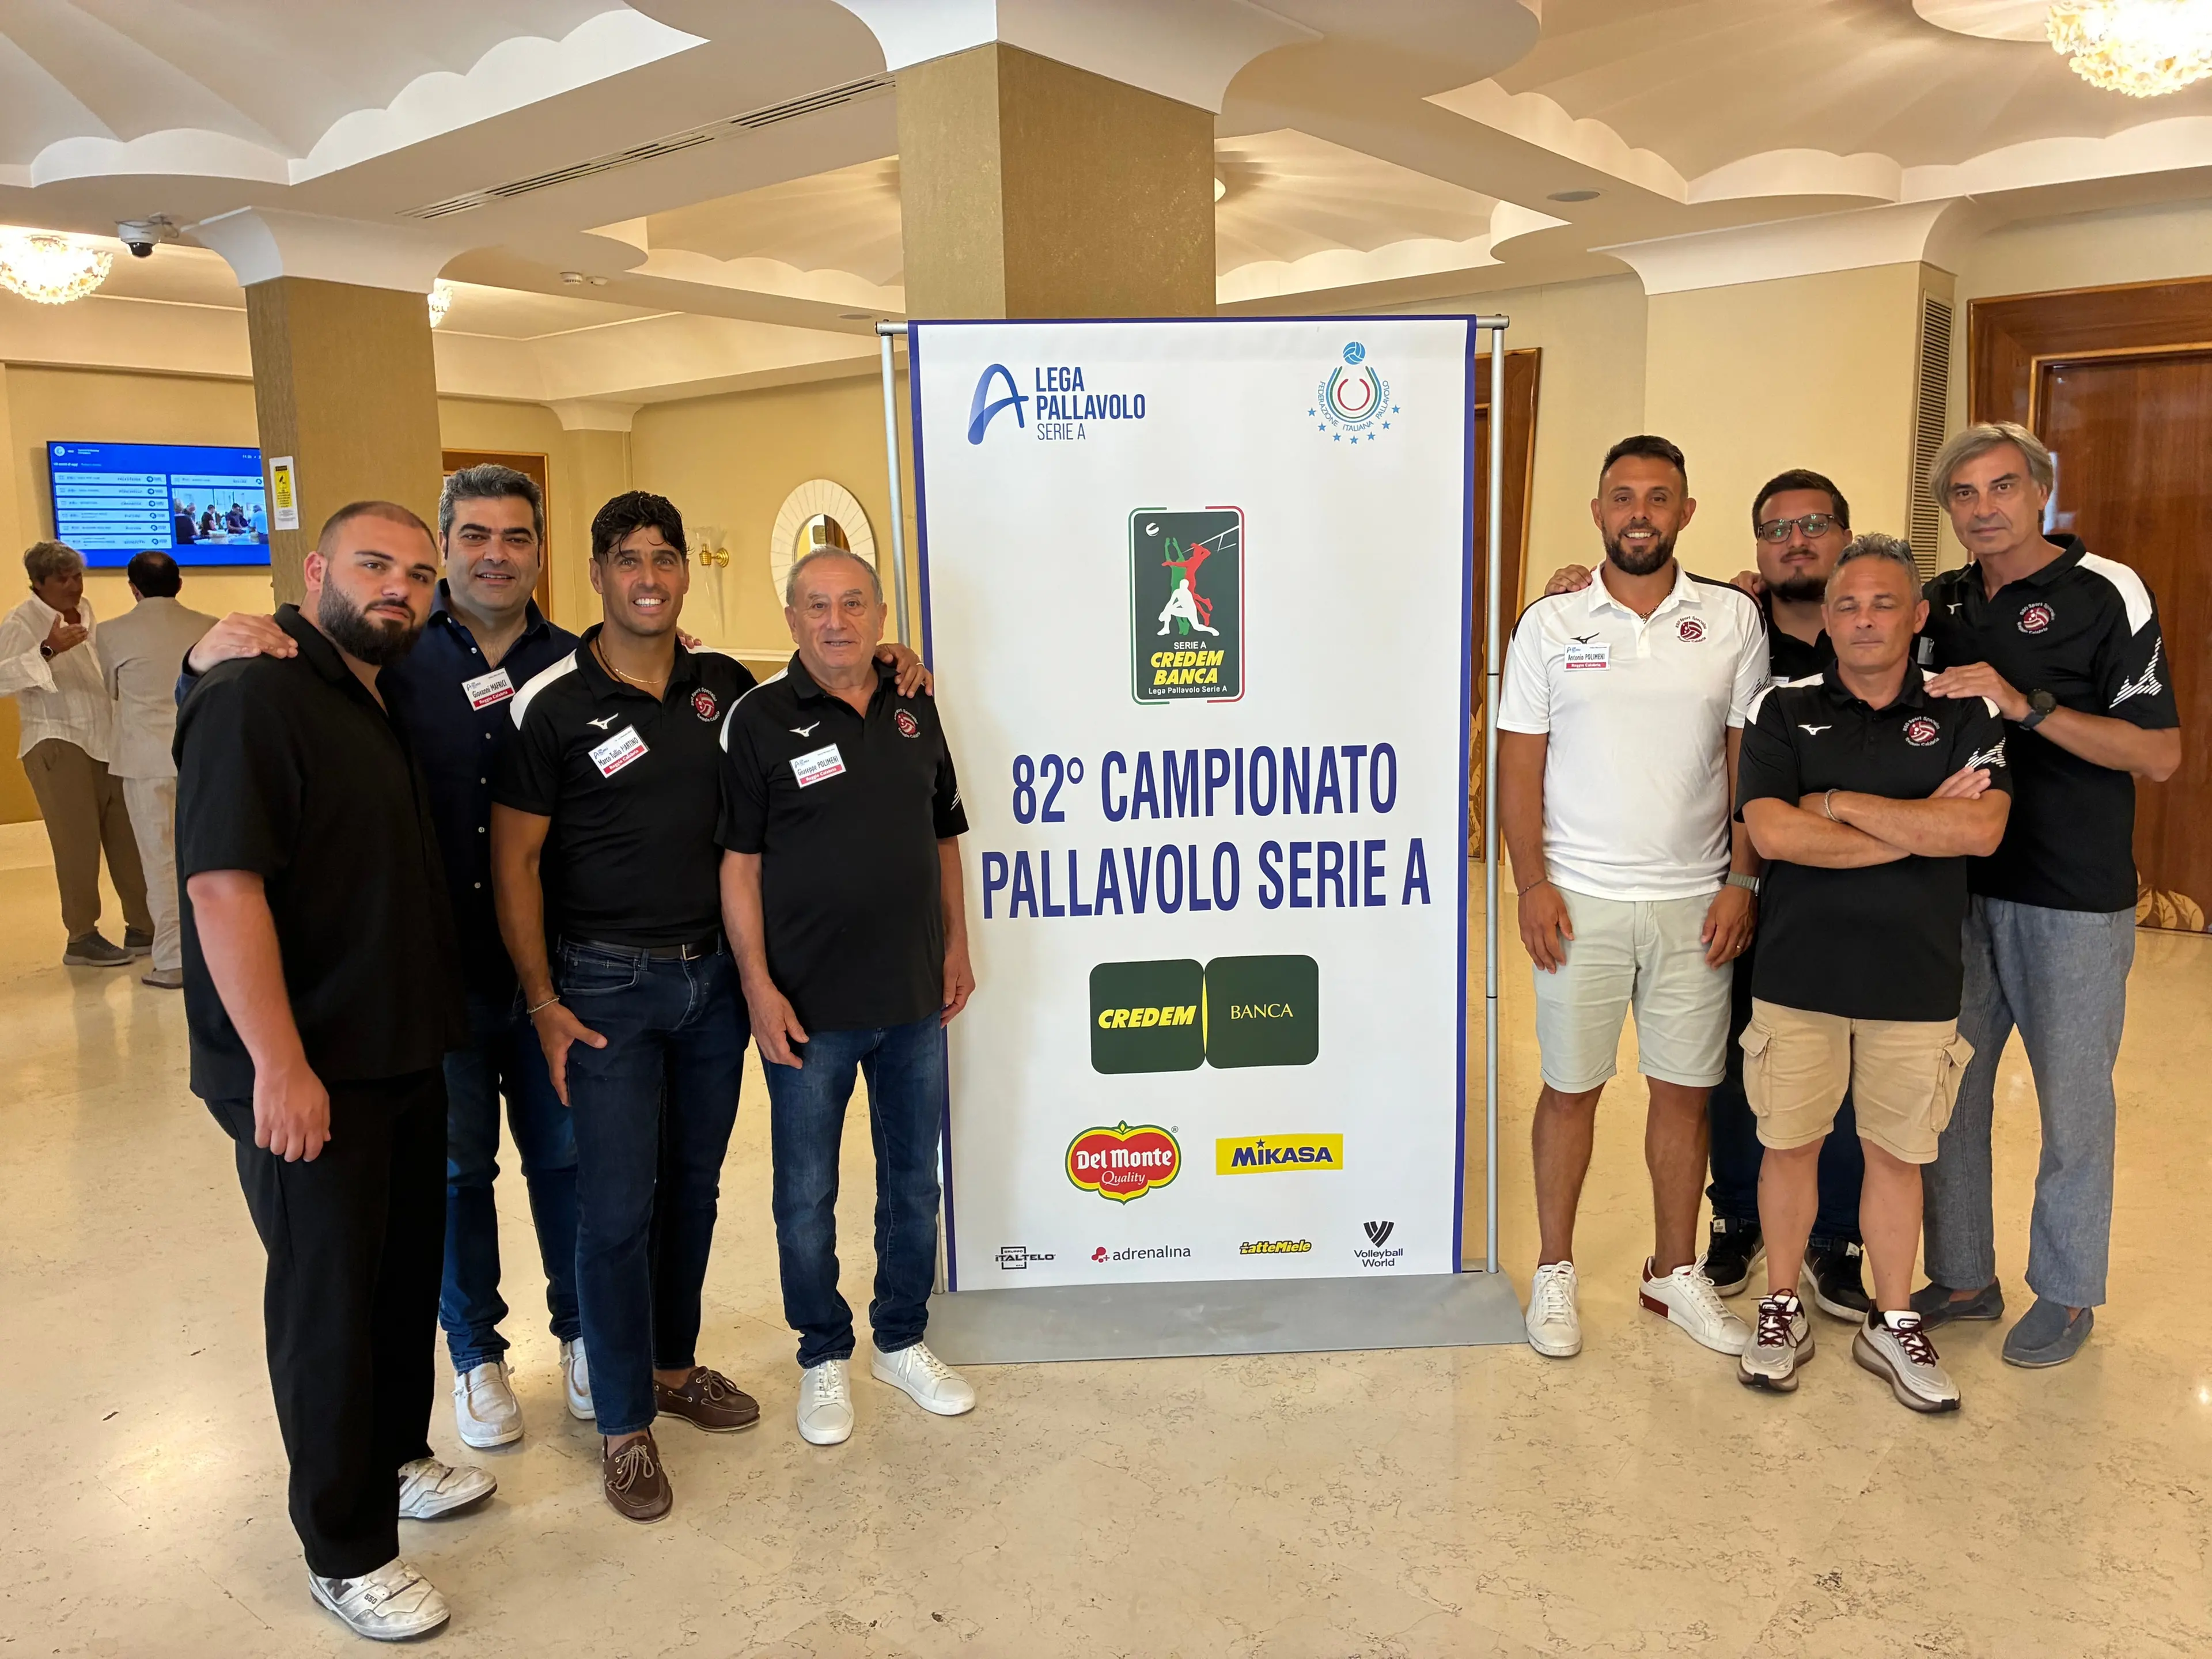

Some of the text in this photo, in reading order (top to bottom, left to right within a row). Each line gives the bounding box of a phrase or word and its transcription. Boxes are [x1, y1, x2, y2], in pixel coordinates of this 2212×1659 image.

[1036, 367, 1085, 392] LEGA
[1036, 394, 1145, 420] PALLAVOLO
[1318, 380, 1390, 431] FEDERAZIONE ITALIANA PALLAVOLO
[1037, 423, 1086, 440] SERIE A
[1173, 641, 1198, 650] SERIE
[1150, 650, 1224, 668] CREDEM
[1153, 668, 1218, 685] BANCA
[472, 685, 491, 698] Giovanni
[493, 691, 508, 699] Calabria
[1168, 686, 1200, 694] Pallavolo
[598, 756, 611, 766] Marco
[609, 749, 622, 759] Tullio
[797, 764, 817, 777] Giuseppe
[817, 755, 839, 769] POLIMENI
[1101, 742, 1397, 823] CAMPIONATO
[982, 838, 1431, 919] PALLAVOLO SERIE A
[1098, 1005, 1197, 1029] CREDEM
[1230, 1003, 1293, 1020] BANCA
[1077, 1149, 1172, 1169] Del Monte
[1101, 1170, 1145, 1186] Quality
[1113, 1245, 1191, 1260] adrenalina
[1240, 1240, 1312, 1254] LatteMiele
[1354, 1248, 1403, 1259] Volleyball
[1362, 1258, 1395, 1267] World
